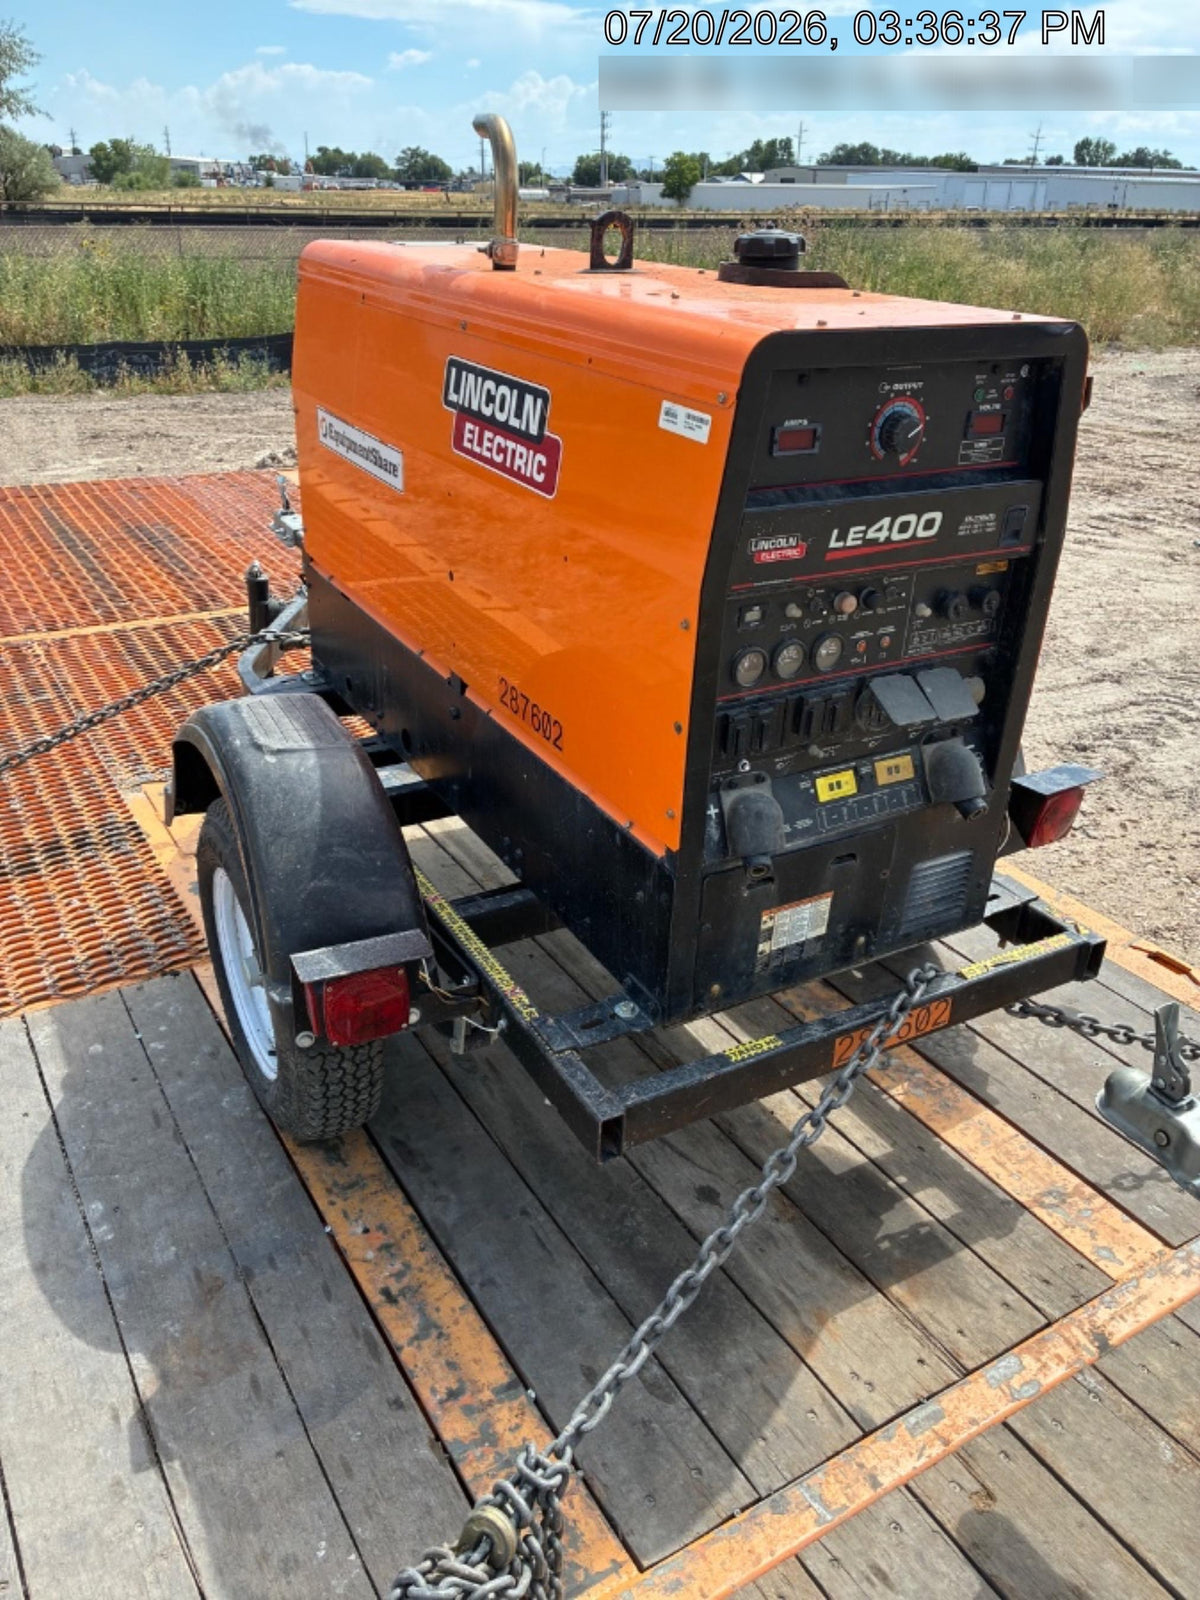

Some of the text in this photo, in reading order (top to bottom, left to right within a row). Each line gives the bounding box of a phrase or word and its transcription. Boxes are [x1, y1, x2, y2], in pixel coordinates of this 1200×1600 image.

[448, 367, 543, 436] LINCOLN
[328, 422, 399, 478] EquipmentShare
[463, 422, 547, 483] ELECTRIC
[750, 536, 798, 553] LINCOLN
[828, 511, 943, 549] LE400
[499, 676, 563, 752] 287602
